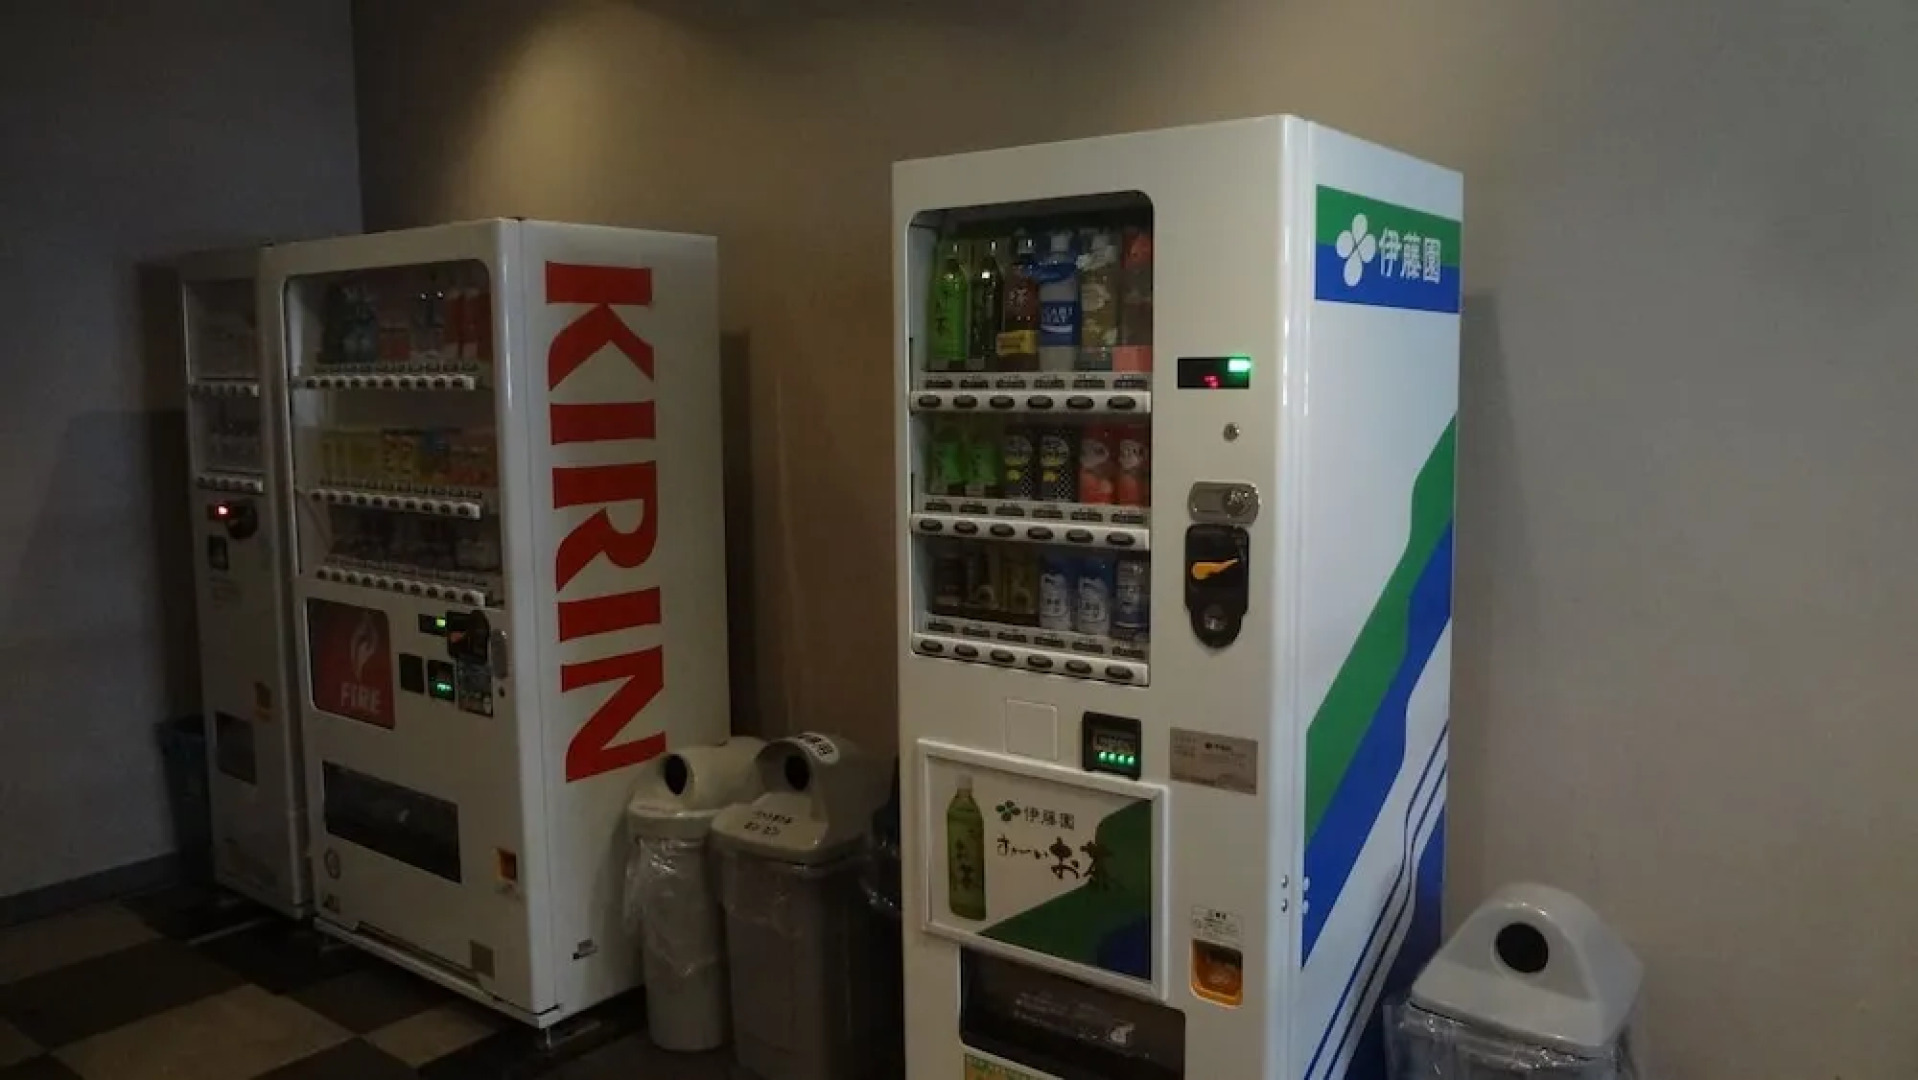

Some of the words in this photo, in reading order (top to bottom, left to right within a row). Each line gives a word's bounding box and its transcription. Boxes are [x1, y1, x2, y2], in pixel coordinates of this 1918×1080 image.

[1379, 226, 1441, 284] 伊藤園
[545, 260, 666, 782] KIRIN
[340, 682, 384, 714] FIRE
[1024, 806, 1074, 830] 伊藤園
